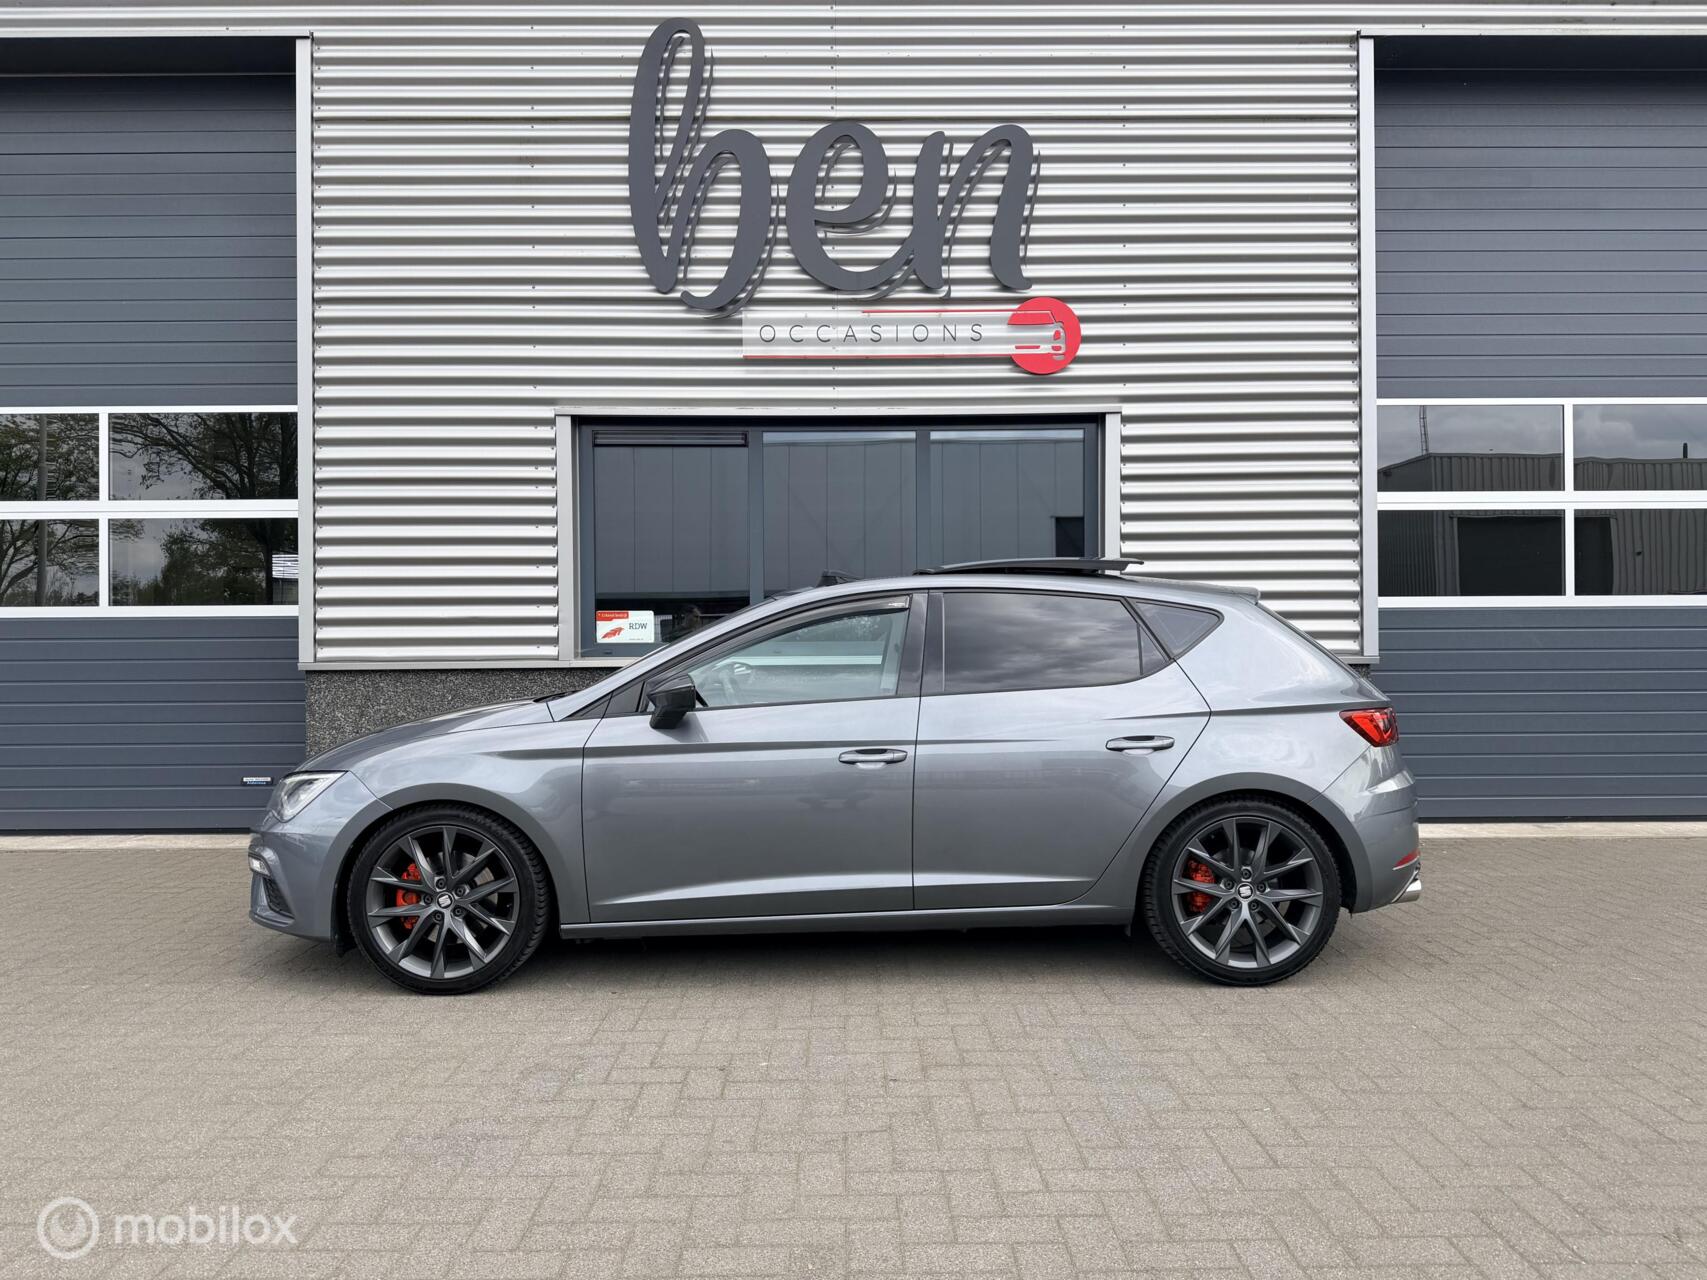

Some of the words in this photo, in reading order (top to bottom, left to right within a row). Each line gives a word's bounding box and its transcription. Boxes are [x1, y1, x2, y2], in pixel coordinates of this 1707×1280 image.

[628, 17, 1034, 311] ben
[759, 324, 983, 343] OCCASIONS
[628, 622, 648, 630] RDW
